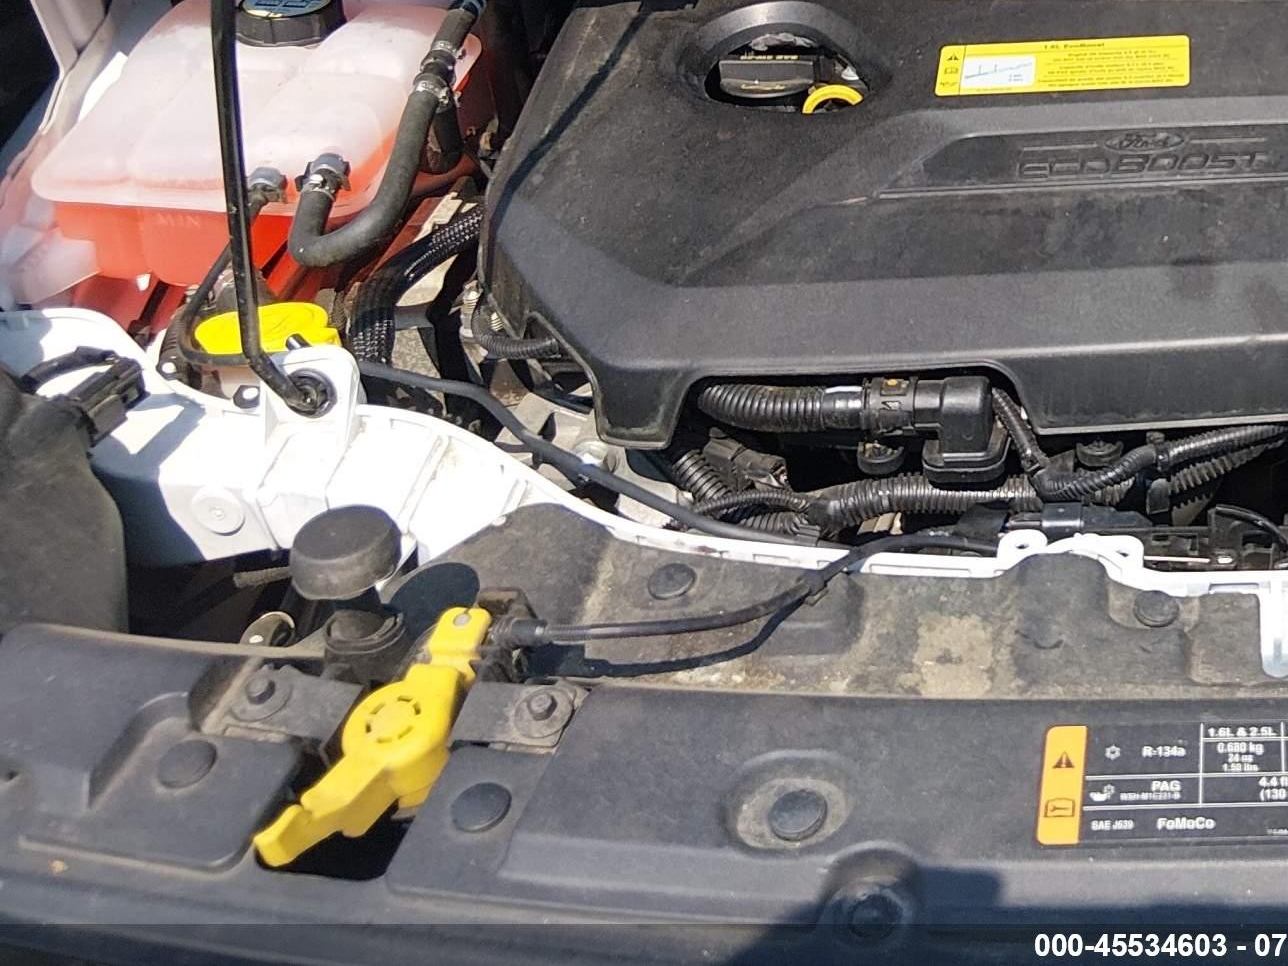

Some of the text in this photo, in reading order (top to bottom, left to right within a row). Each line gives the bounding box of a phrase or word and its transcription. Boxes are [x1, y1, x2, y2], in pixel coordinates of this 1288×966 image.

[1018, 152, 1266, 179] ECOBOOST
[1236, 727, 1247, 737] &
[1141, 745, 1187, 758] R-134a
[1249, 741, 1264, 755] kg
[1151, 780, 1181, 792] PAG
[1258, 777, 1278, 787] 4.4
[1259, 788, 1287, 801] (130
[1091, 820, 1112, 831] SAE
[1156, 816, 1216, 831] FoMoCo
